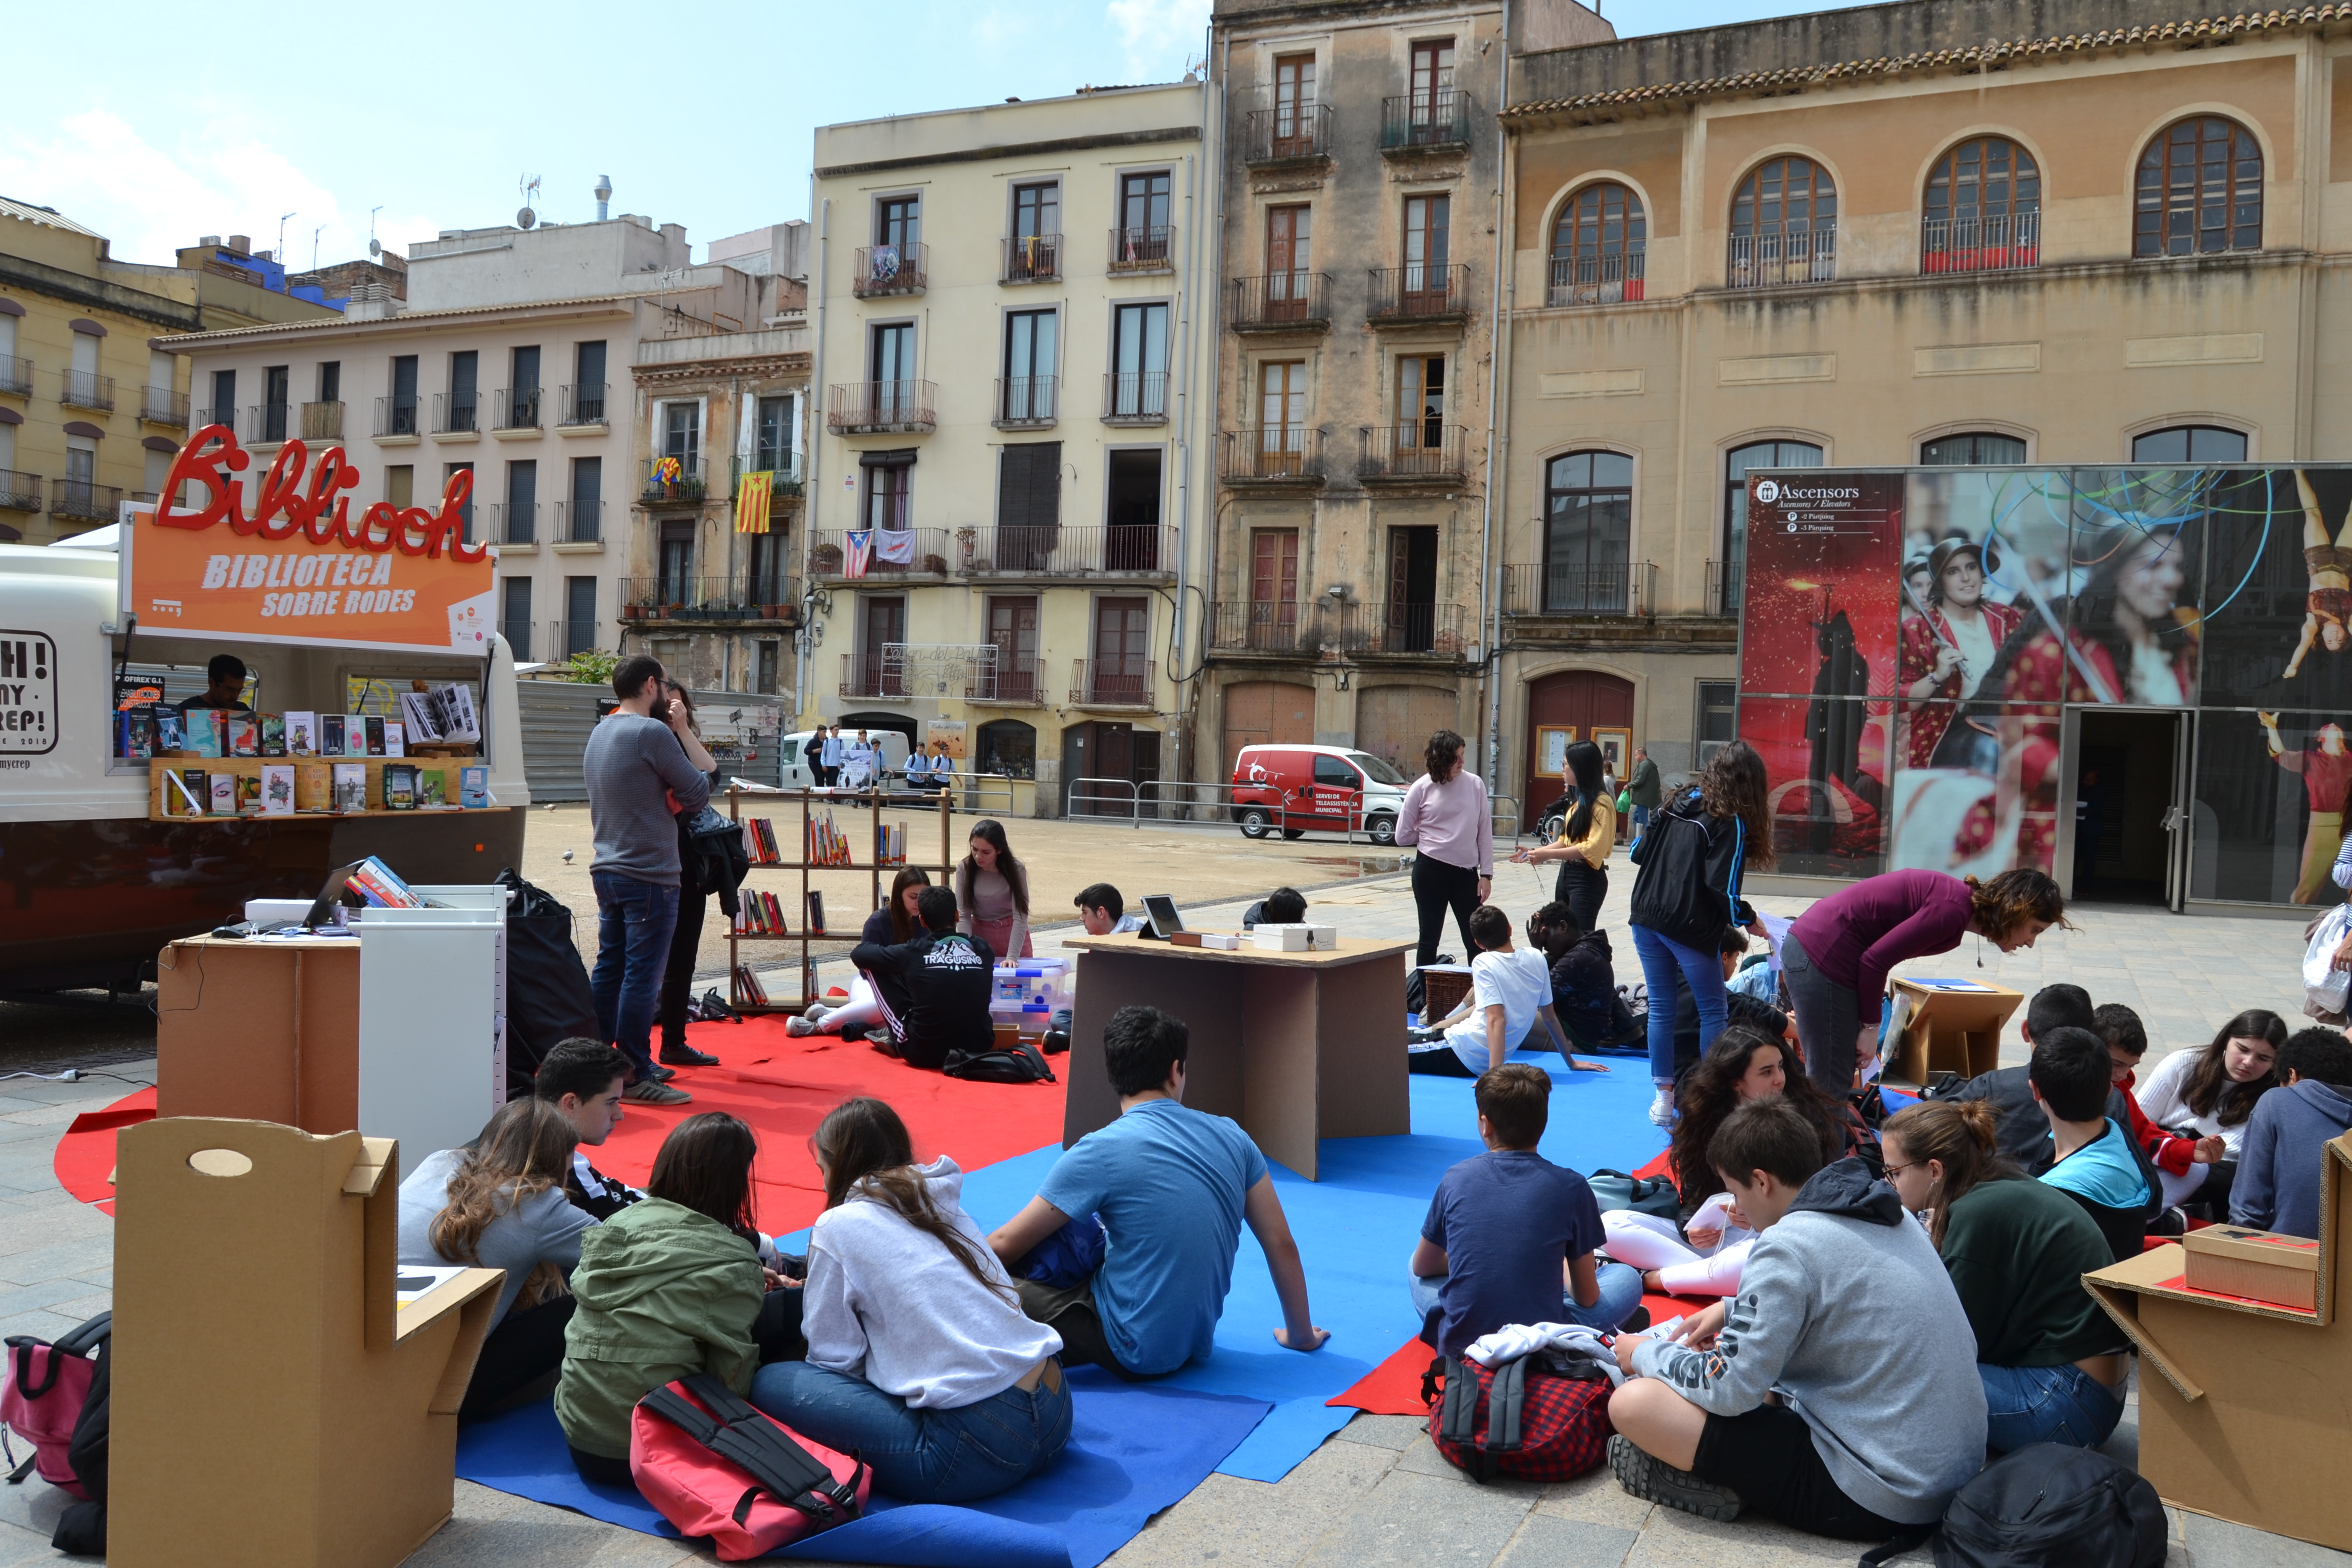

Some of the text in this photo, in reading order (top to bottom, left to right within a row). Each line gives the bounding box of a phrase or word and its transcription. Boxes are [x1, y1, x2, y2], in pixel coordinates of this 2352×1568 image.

[154, 424, 486, 563] Bibliooh
[1778, 484, 1859, 499] Ascensors
[201, 554, 392, 589] BIBLIOTECA
[260, 589, 416, 617] SOBRE RODES
[930, 646, 950, 661] del
[118, 688, 161, 699] EHABILITACIONES
[0, 710, 45, 732] EP!
[0, 760, 30, 770] mycrep
[923, 955, 982, 965] TRAGUSINO
